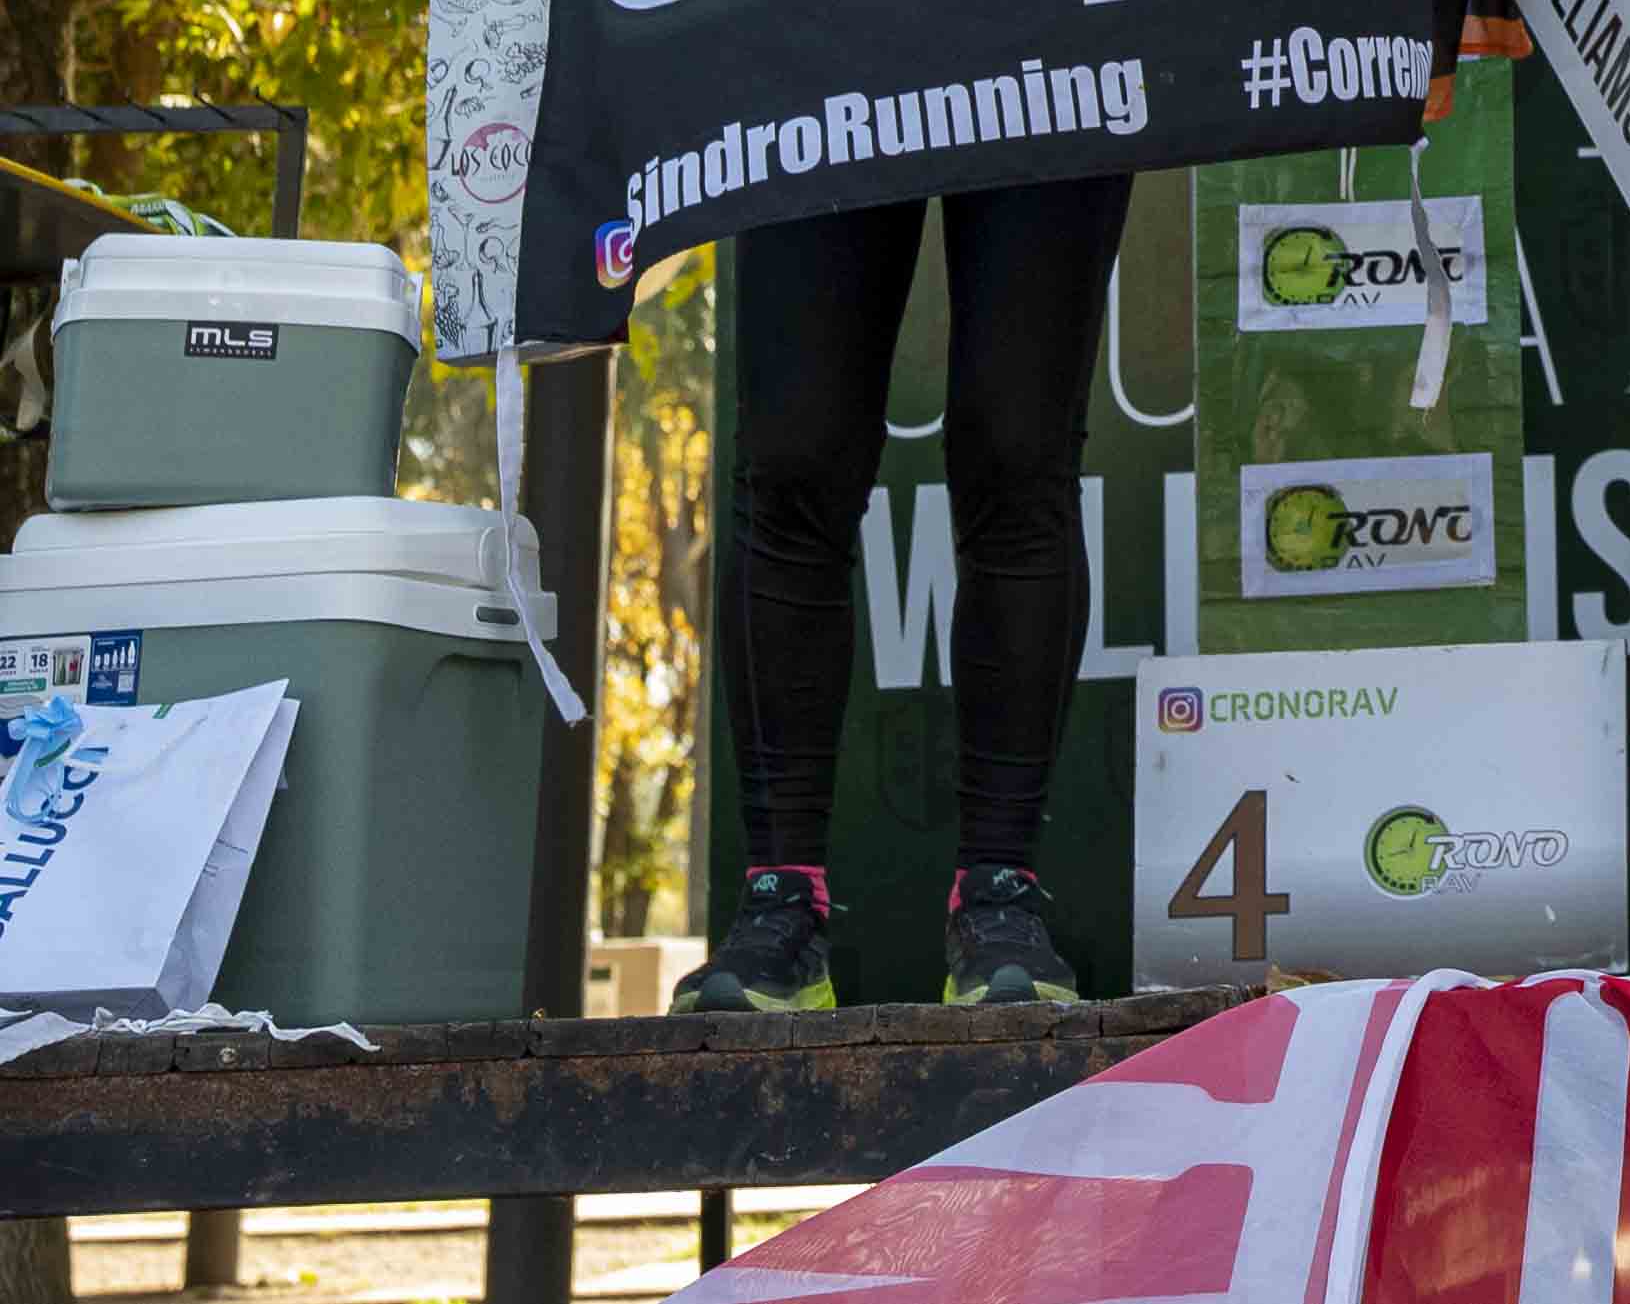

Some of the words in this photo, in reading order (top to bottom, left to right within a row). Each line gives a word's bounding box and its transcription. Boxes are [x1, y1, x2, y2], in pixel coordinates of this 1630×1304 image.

[451, 147, 481, 177] LOS
[31, 653, 48, 667] 18
[1208, 686, 1398, 724] CRONORAV
[1166, 789, 1291, 961] 4
